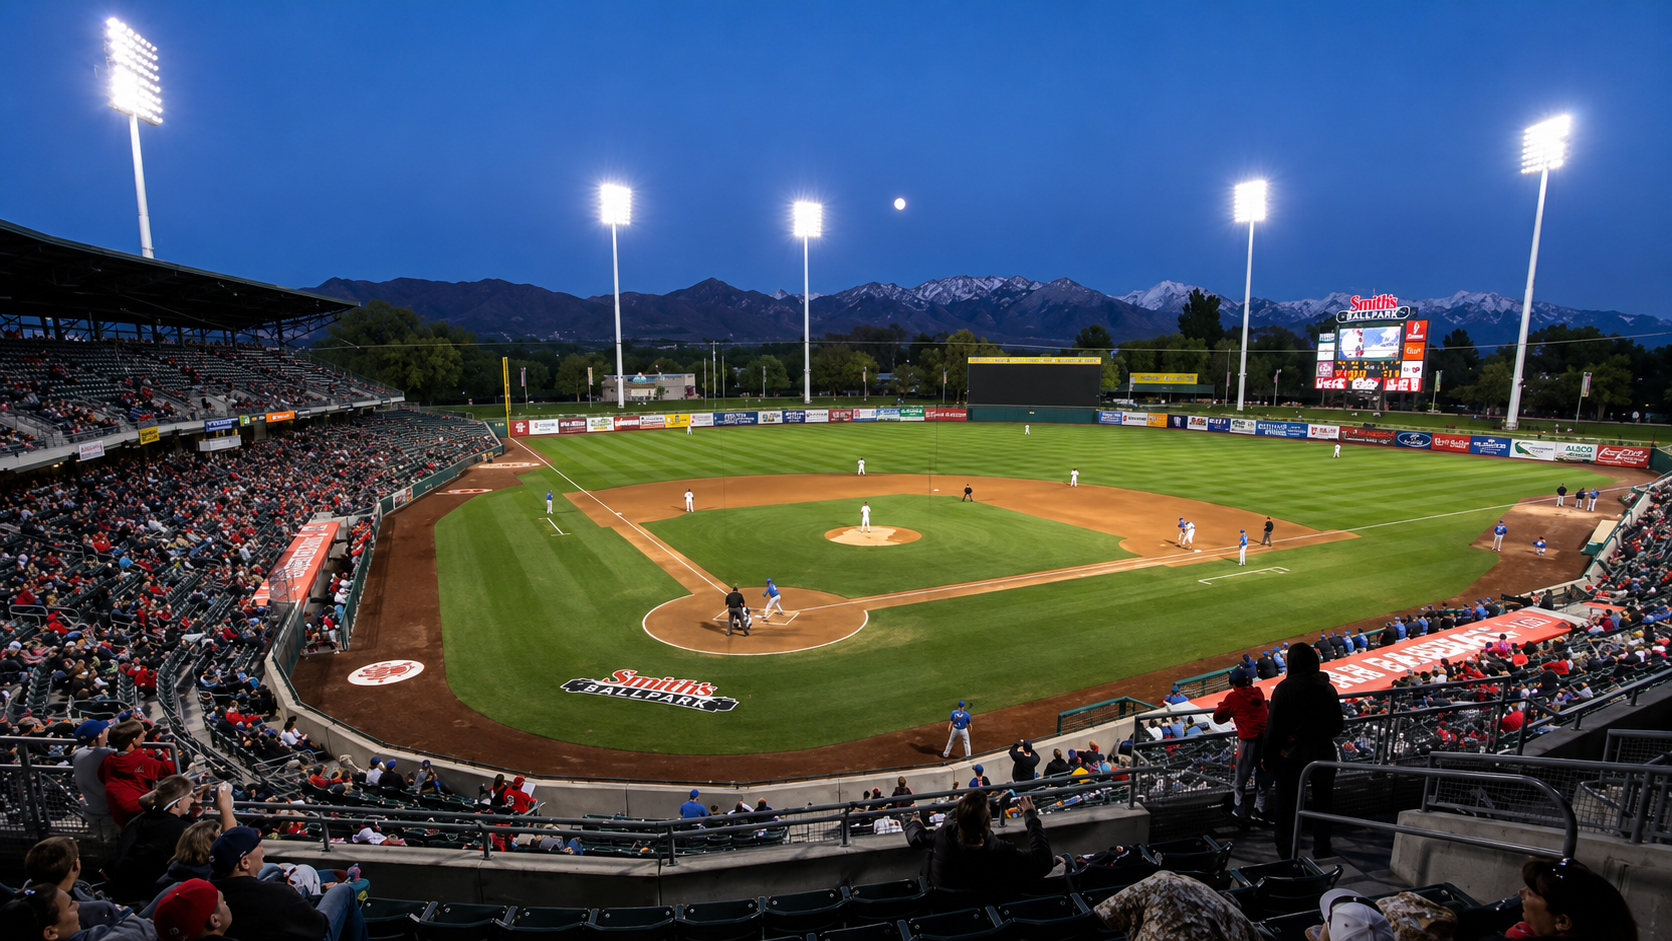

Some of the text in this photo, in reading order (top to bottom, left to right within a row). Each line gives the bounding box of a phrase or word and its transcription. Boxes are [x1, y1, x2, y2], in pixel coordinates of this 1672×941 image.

[1351, 295, 1398, 312] Smith's
[604, 669, 718, 696] Smith's
[584, 685, 709, 709] BALLPARK
